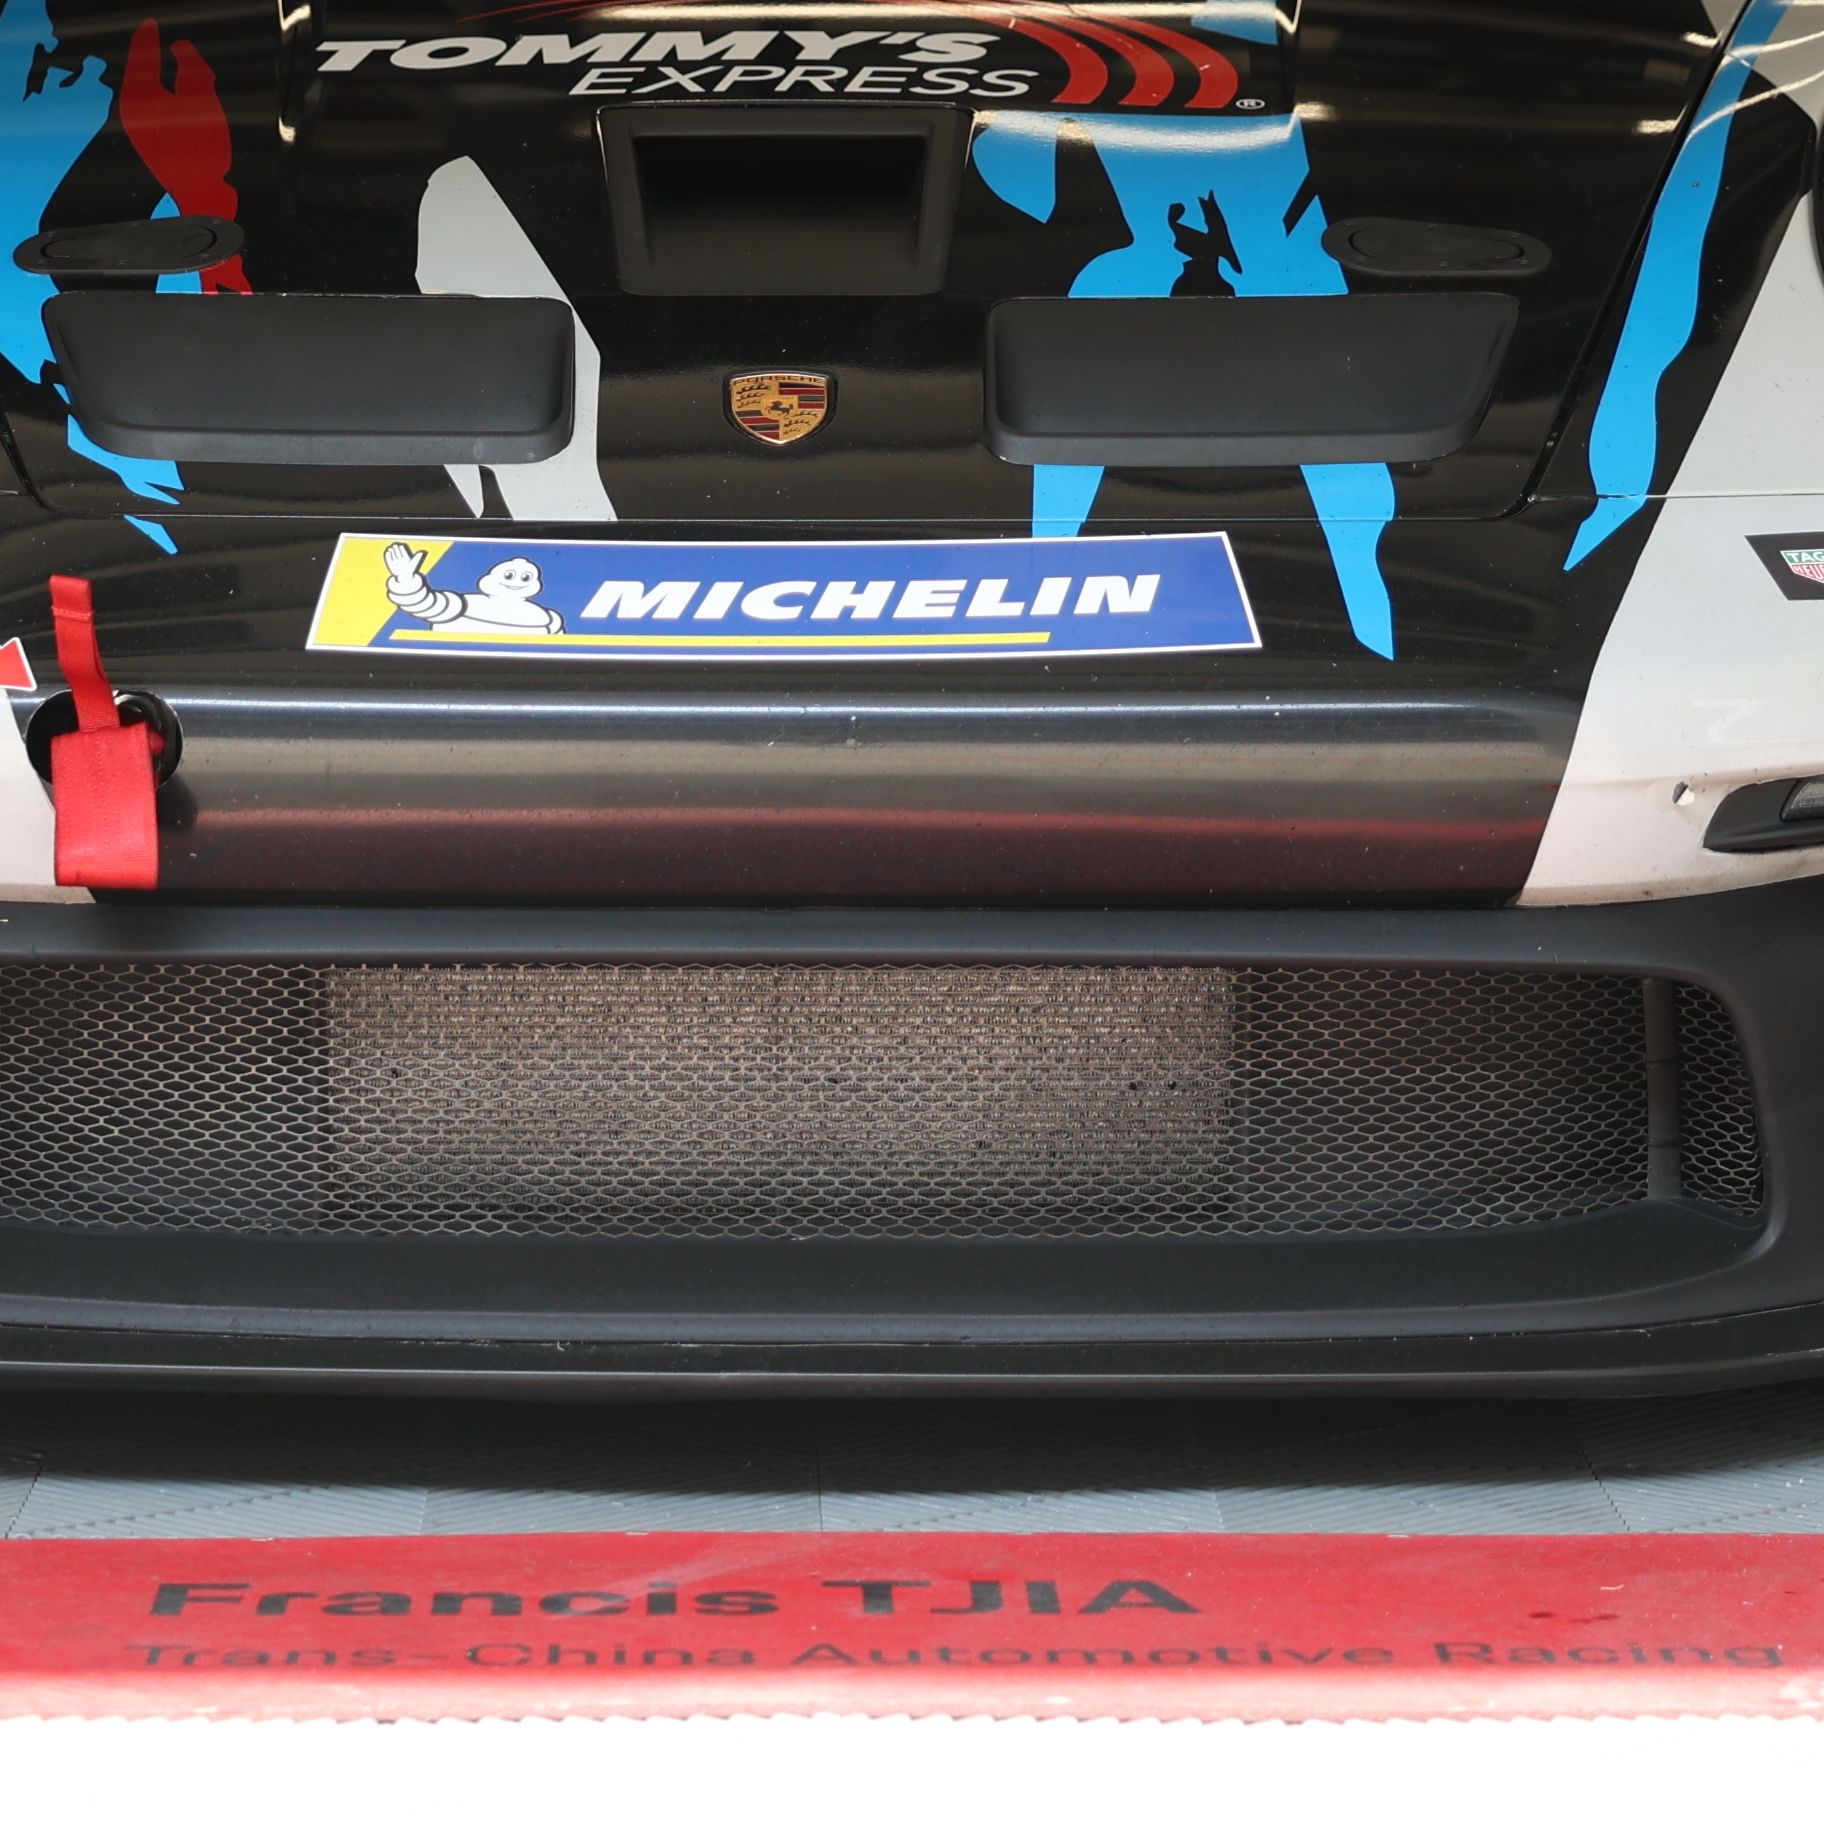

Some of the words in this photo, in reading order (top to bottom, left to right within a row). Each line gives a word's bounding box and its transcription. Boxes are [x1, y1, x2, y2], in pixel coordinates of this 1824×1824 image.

[315, 30, 1001, 72] TOMMY'S
[569, 66, 1040, 98] EXPRESS
[579, 574, 1162, 621] MICHELIN
[149, 1582, 779, 1616] Francis
[821, 1580, 1202, 1614] TJIA
[790, 1642, 1395, 1666] Automotive
[1432, 1641, 1785, 1668] Racing
